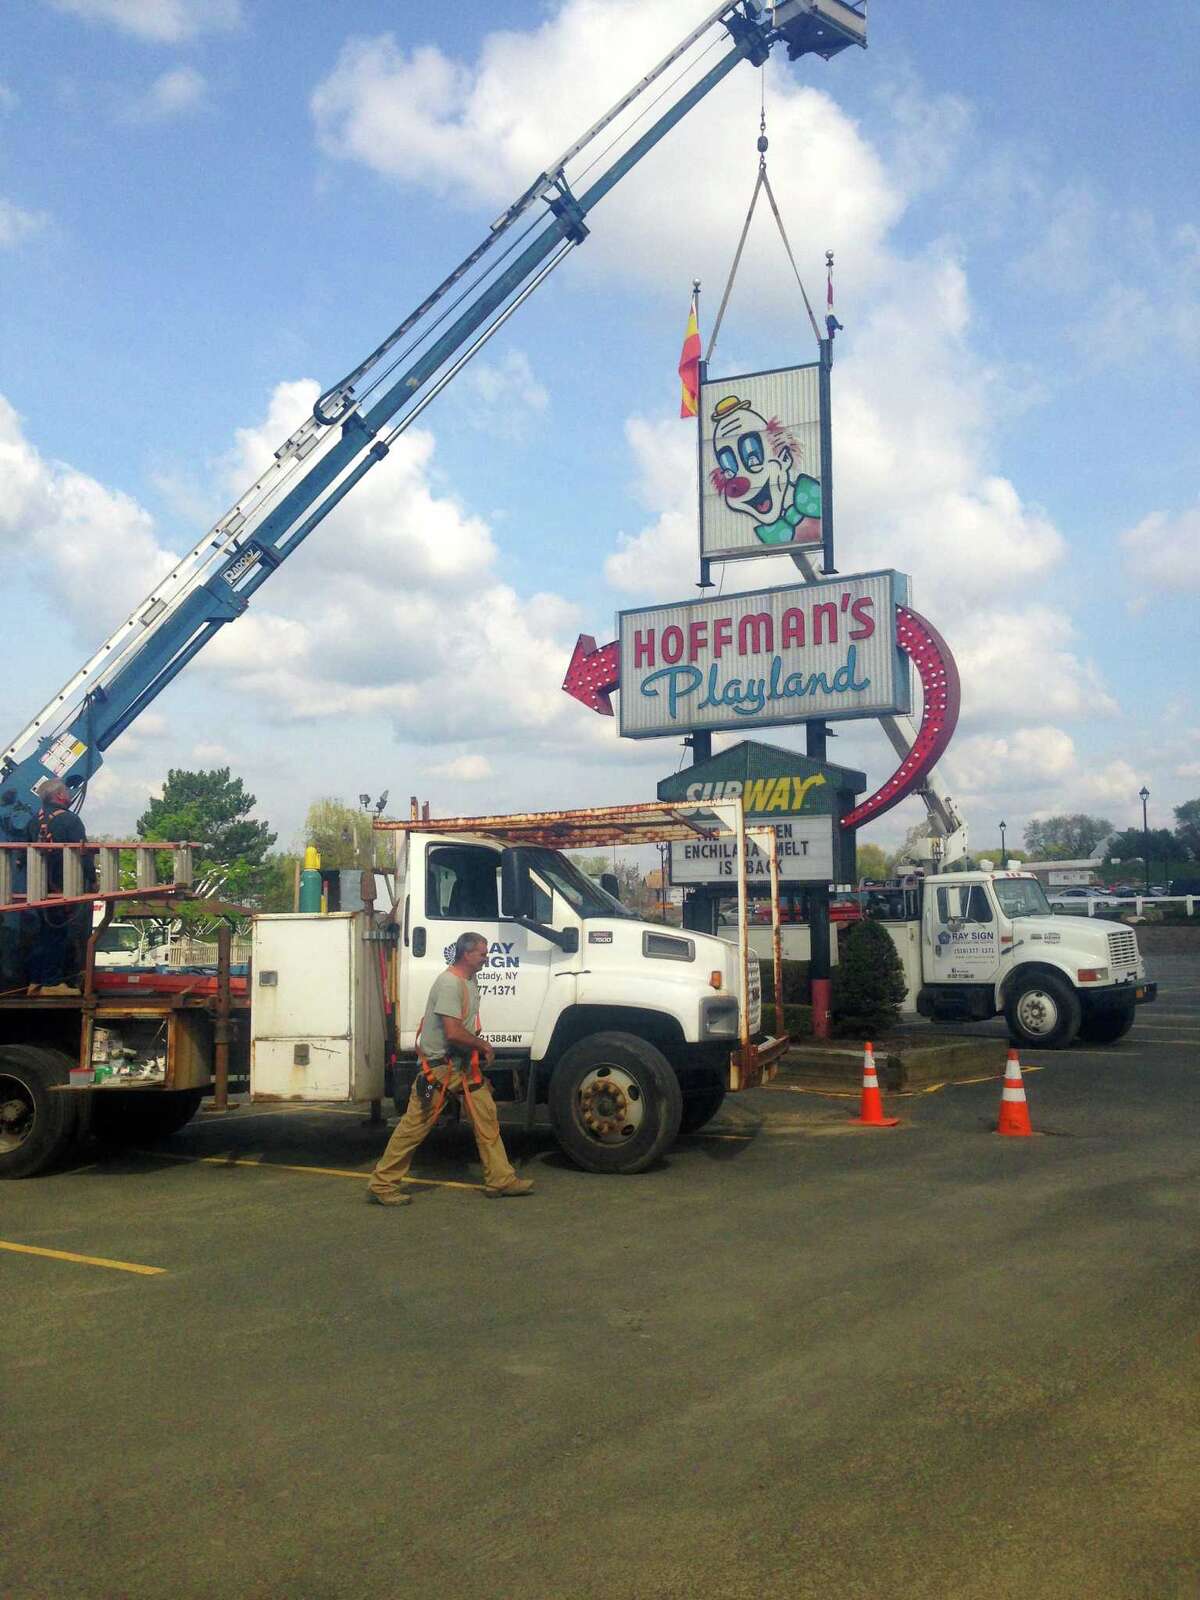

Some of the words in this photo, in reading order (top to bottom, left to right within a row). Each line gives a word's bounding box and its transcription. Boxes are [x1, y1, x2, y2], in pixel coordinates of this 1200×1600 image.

[640, 645, 871, 720] Playland
[680, 773, 827, 816] SUBWAY
[776, 841, 809, 856] MELT
[719, 861, 732, 875] IS
[952, 932, 969, 941] RAY
[971, 931, 994, 940] SIGN
[488, 942, 515, 954] AY
[483, 956, 520, 968] IGN
[477, 971, 503, 981] ctady,
[505, 971, 518, 980] NY
